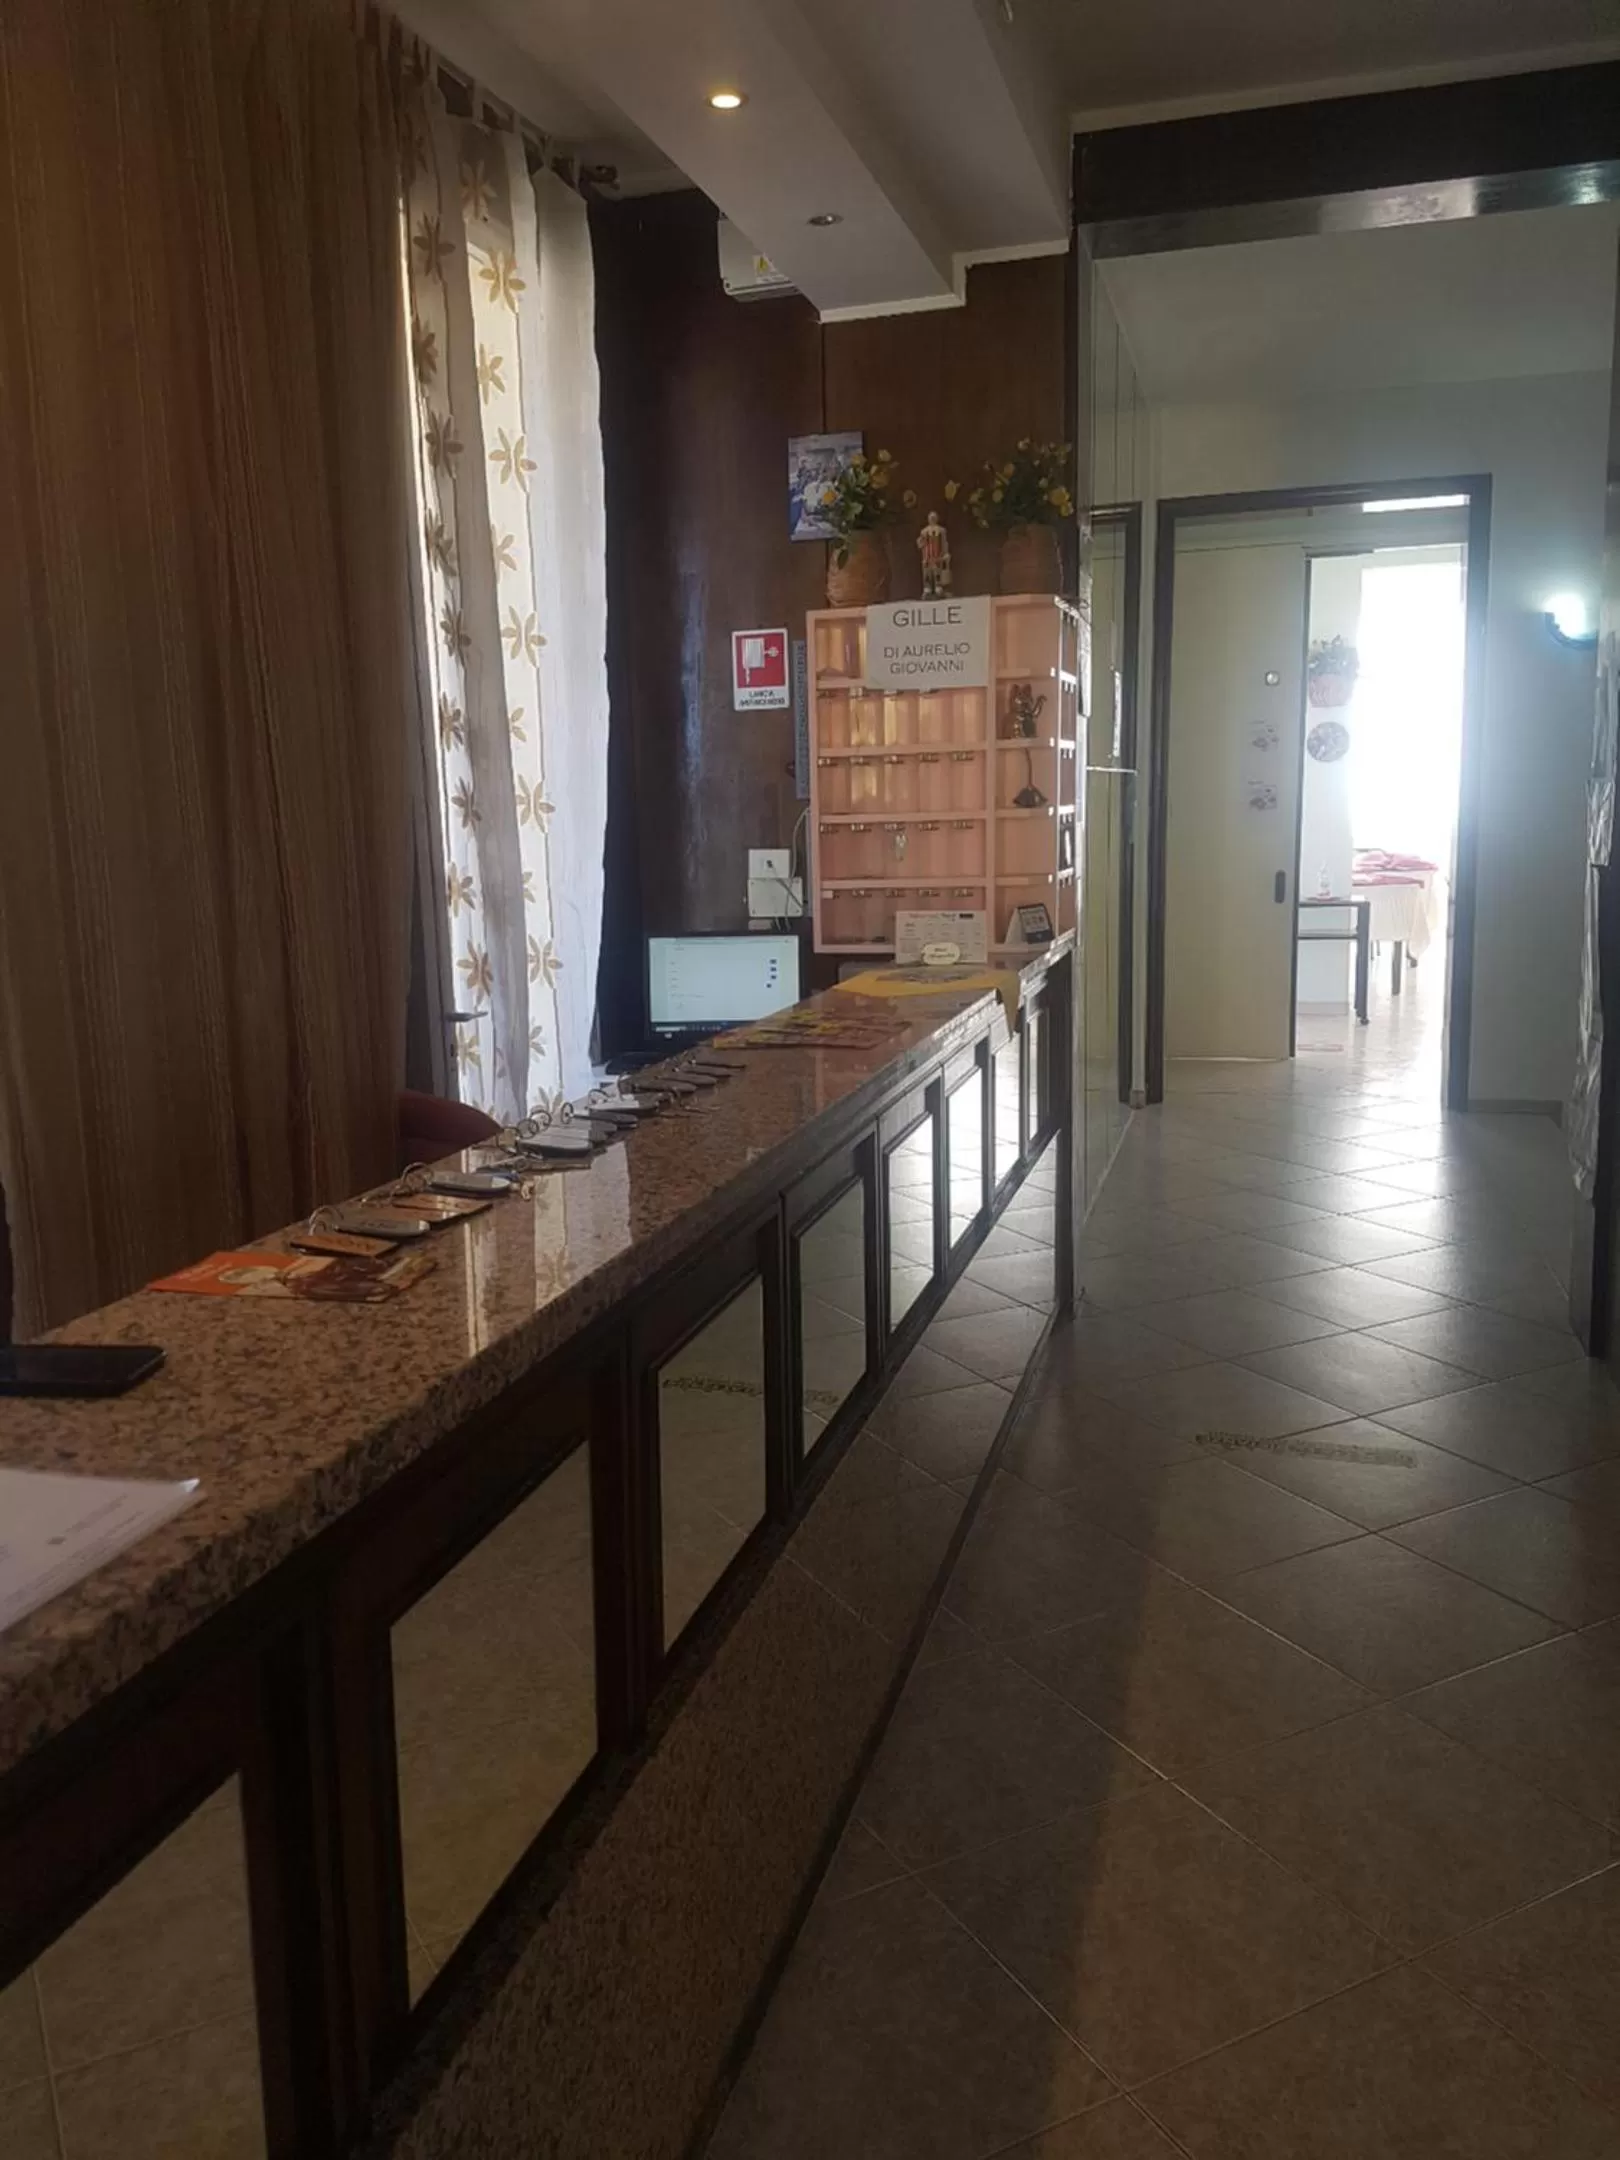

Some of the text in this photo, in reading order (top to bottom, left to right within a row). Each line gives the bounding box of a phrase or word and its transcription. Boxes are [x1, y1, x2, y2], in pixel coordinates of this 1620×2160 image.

[893, 606, 962, 627] GILLE
[884, 642, 970, 659] DI AURELIO
[889, 660, 964, 674] GIOVANNI
